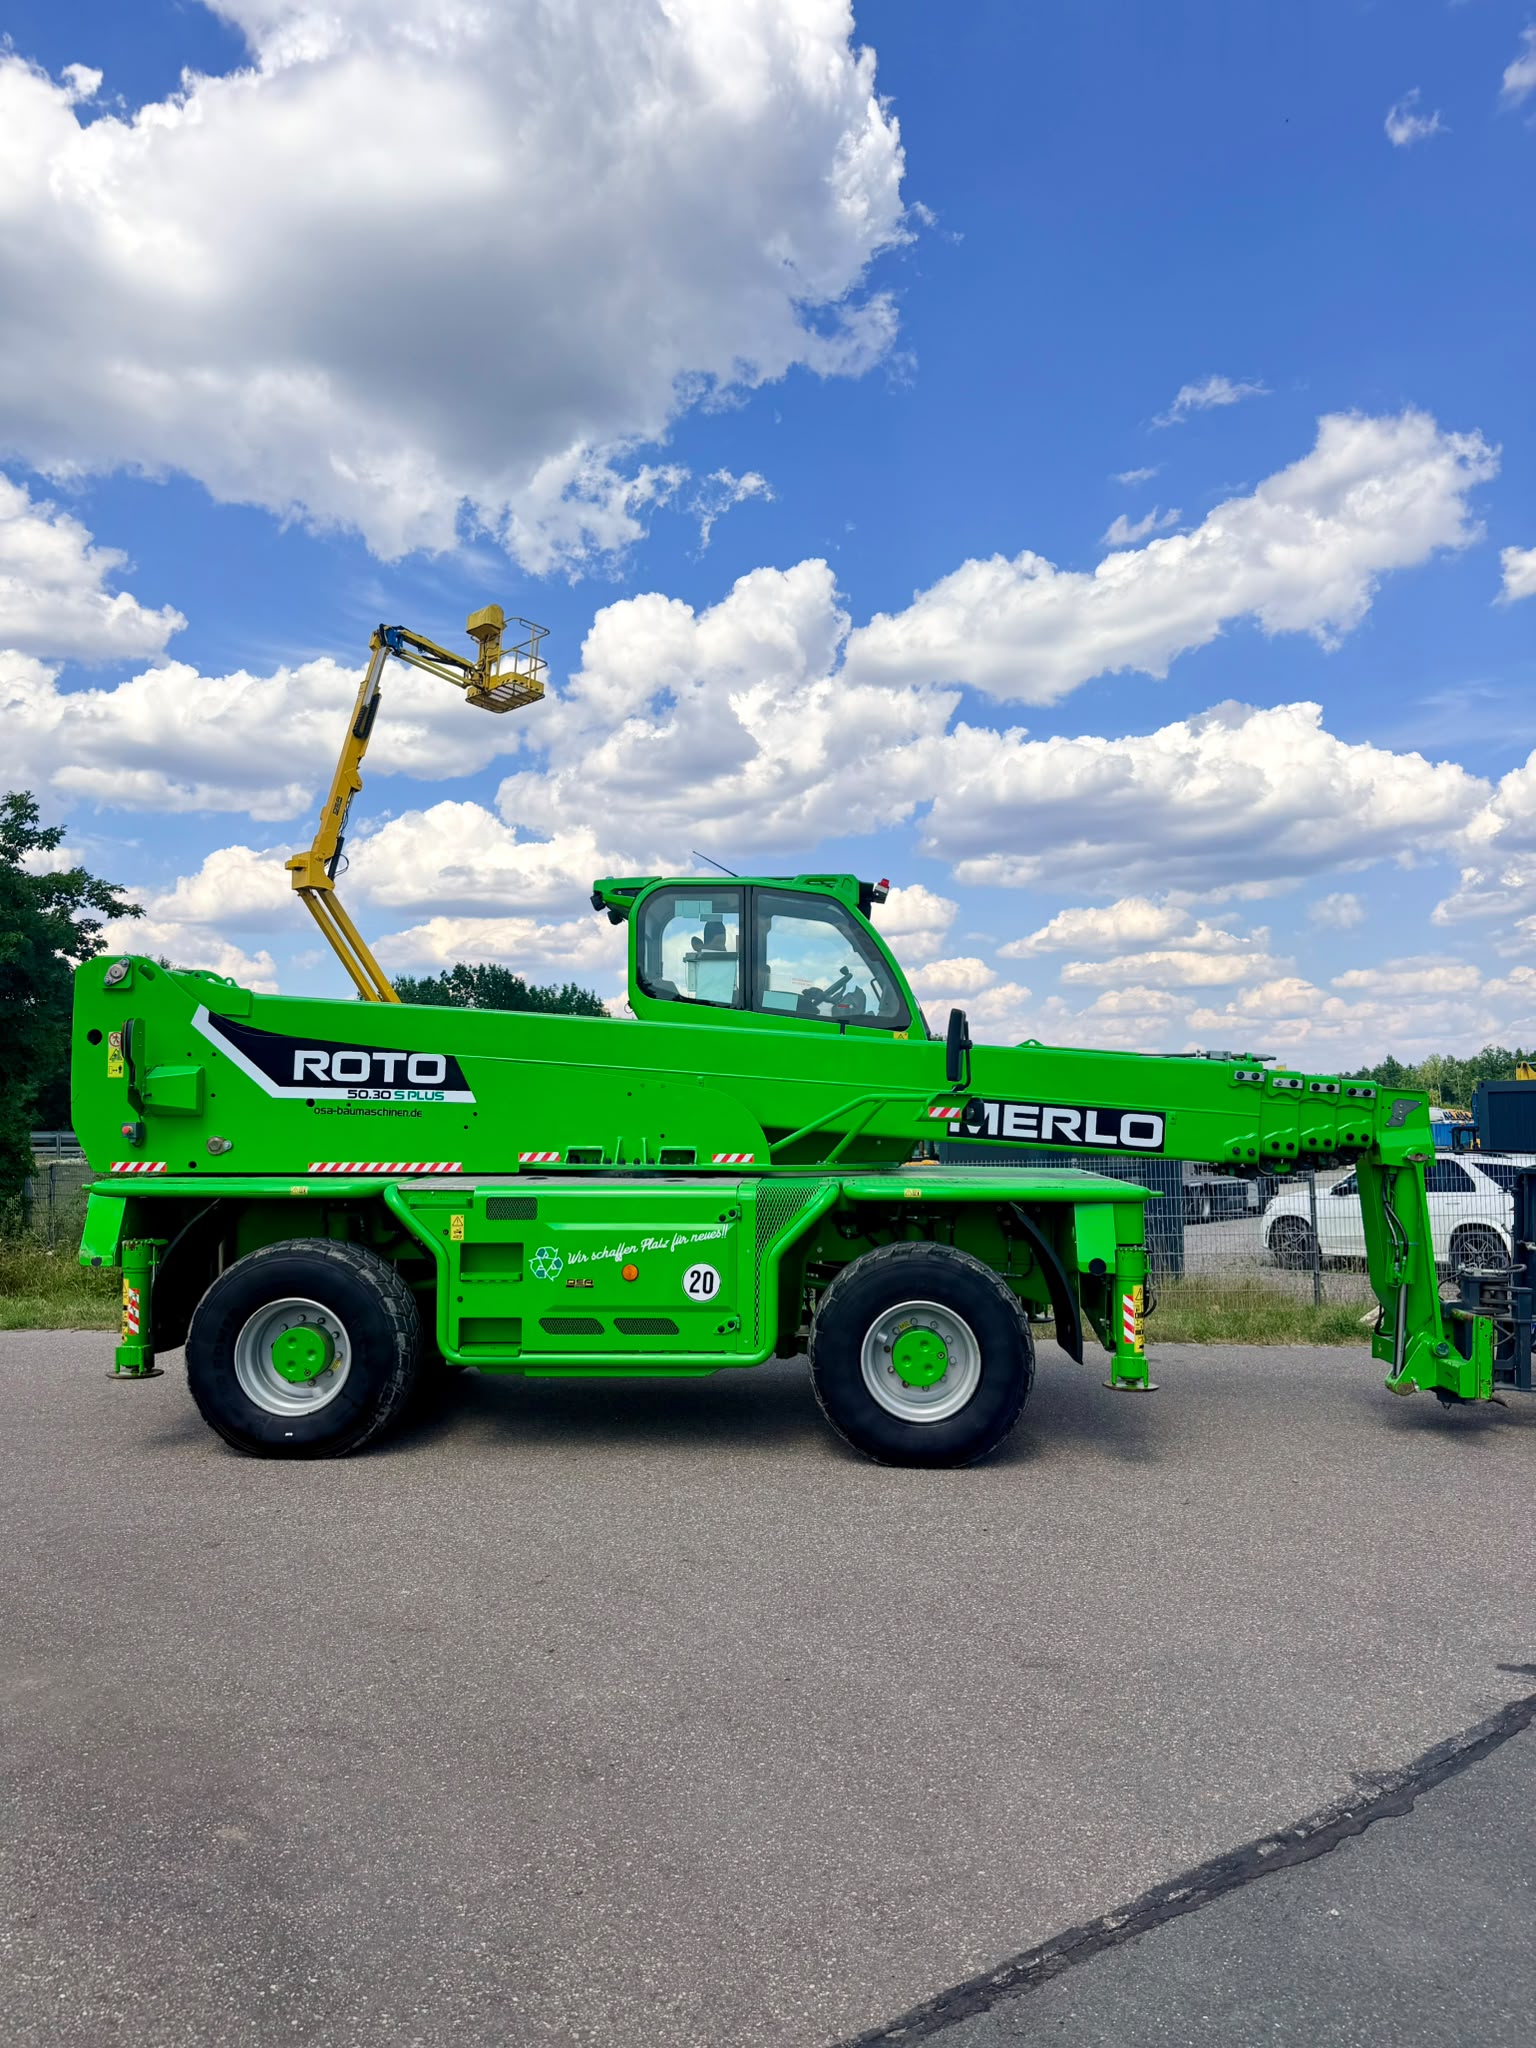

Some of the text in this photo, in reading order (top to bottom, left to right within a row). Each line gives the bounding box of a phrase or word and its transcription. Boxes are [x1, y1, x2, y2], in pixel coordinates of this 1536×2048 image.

[293, 1050, 446, 1084] ROTO
[347, 1089, 445, 1102] 50.30 S PLUS
[314, 1107, 422, 1118] osa-baumaschinen.de
[567, 1224, 728, 1265] Wir schaffen Platz für neues!!
[689, 1270, 714, 1295] 20
